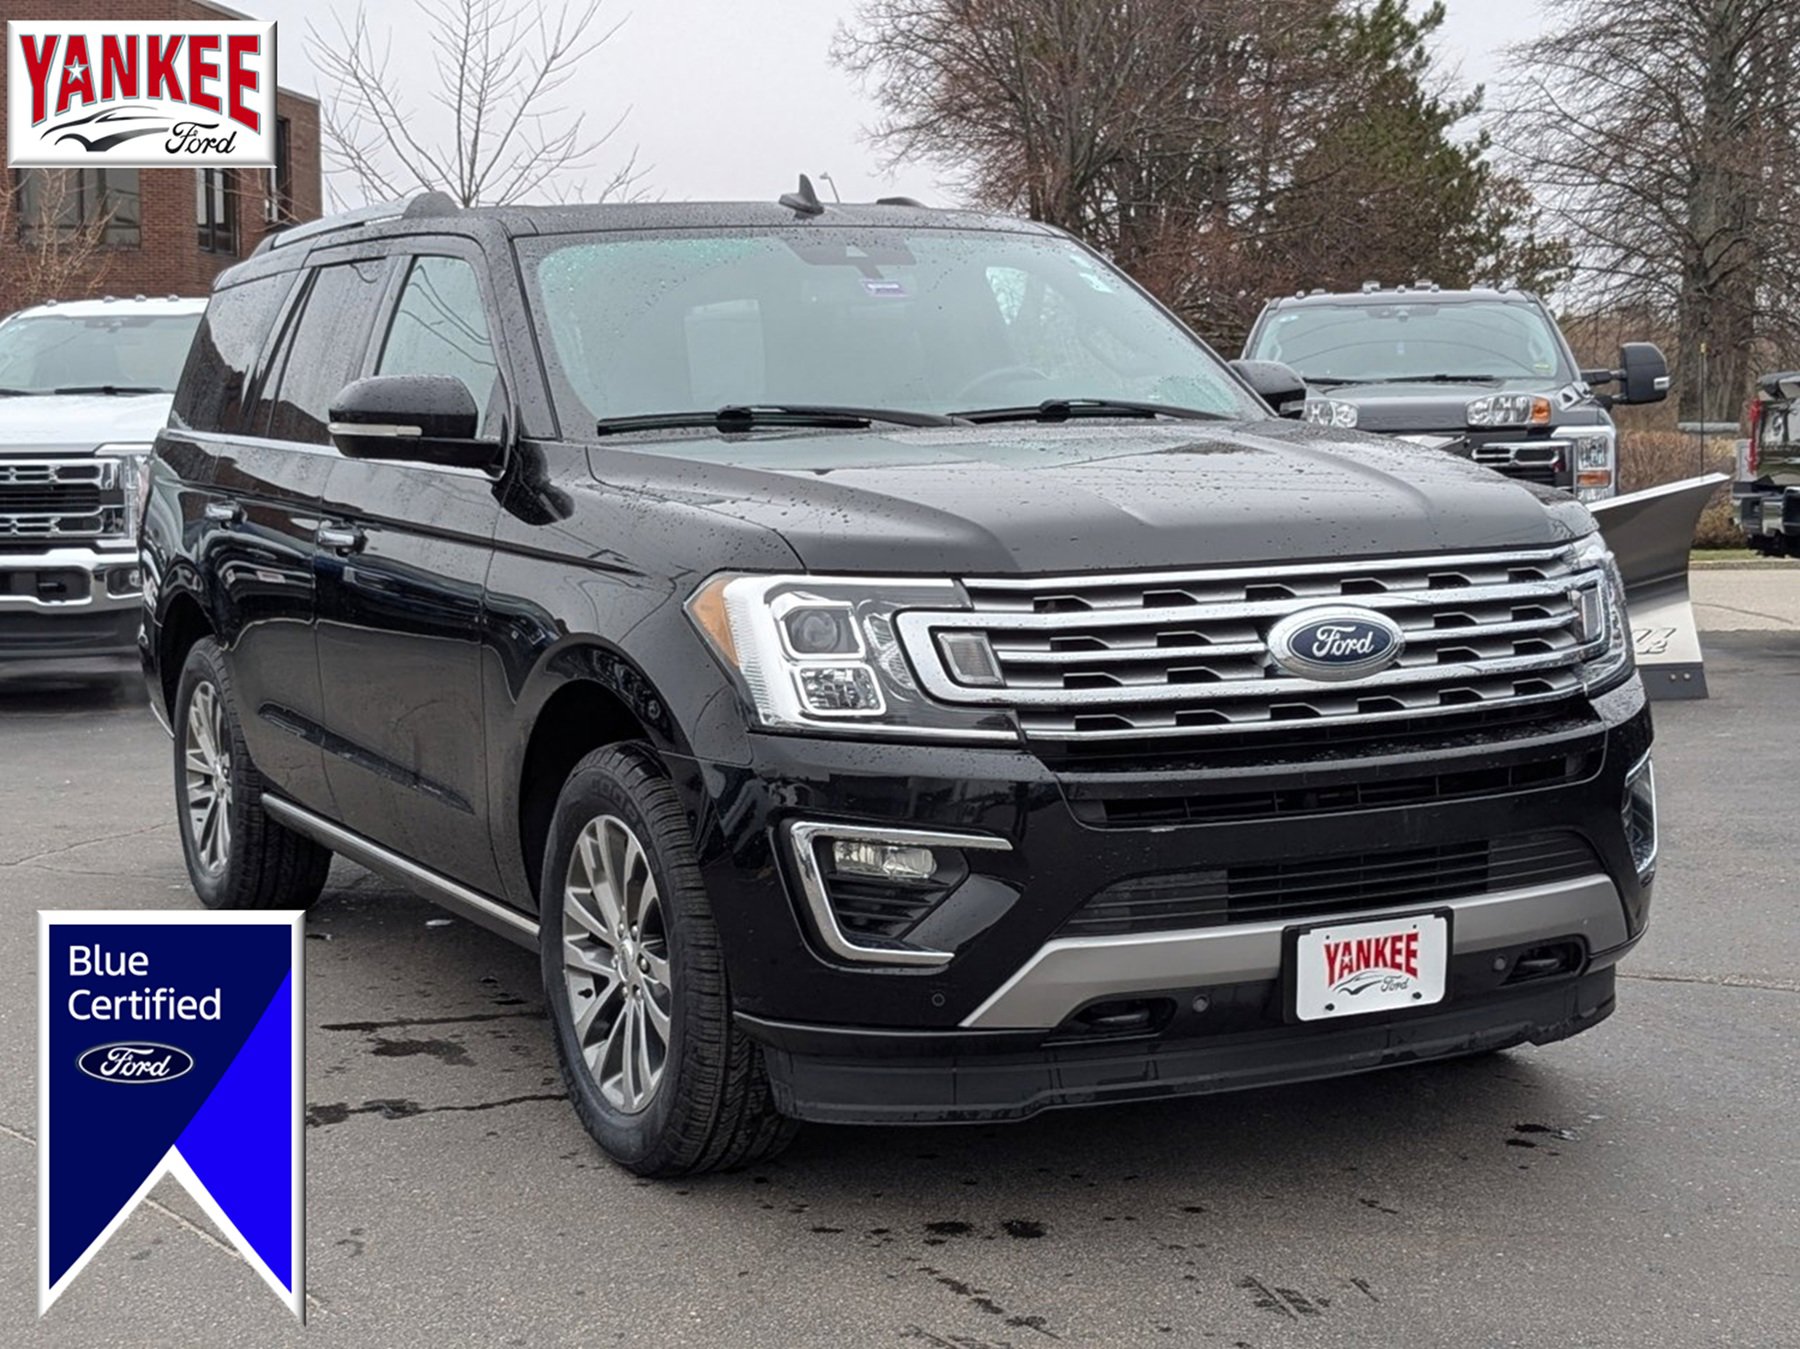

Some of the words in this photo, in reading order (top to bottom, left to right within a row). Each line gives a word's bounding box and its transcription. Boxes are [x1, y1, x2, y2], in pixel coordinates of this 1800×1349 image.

[1312, 625, 1374, 657] Ford
[1324, 932, 1419, 987] YANKEE
[1381, 975, 1410, 992] Ford
